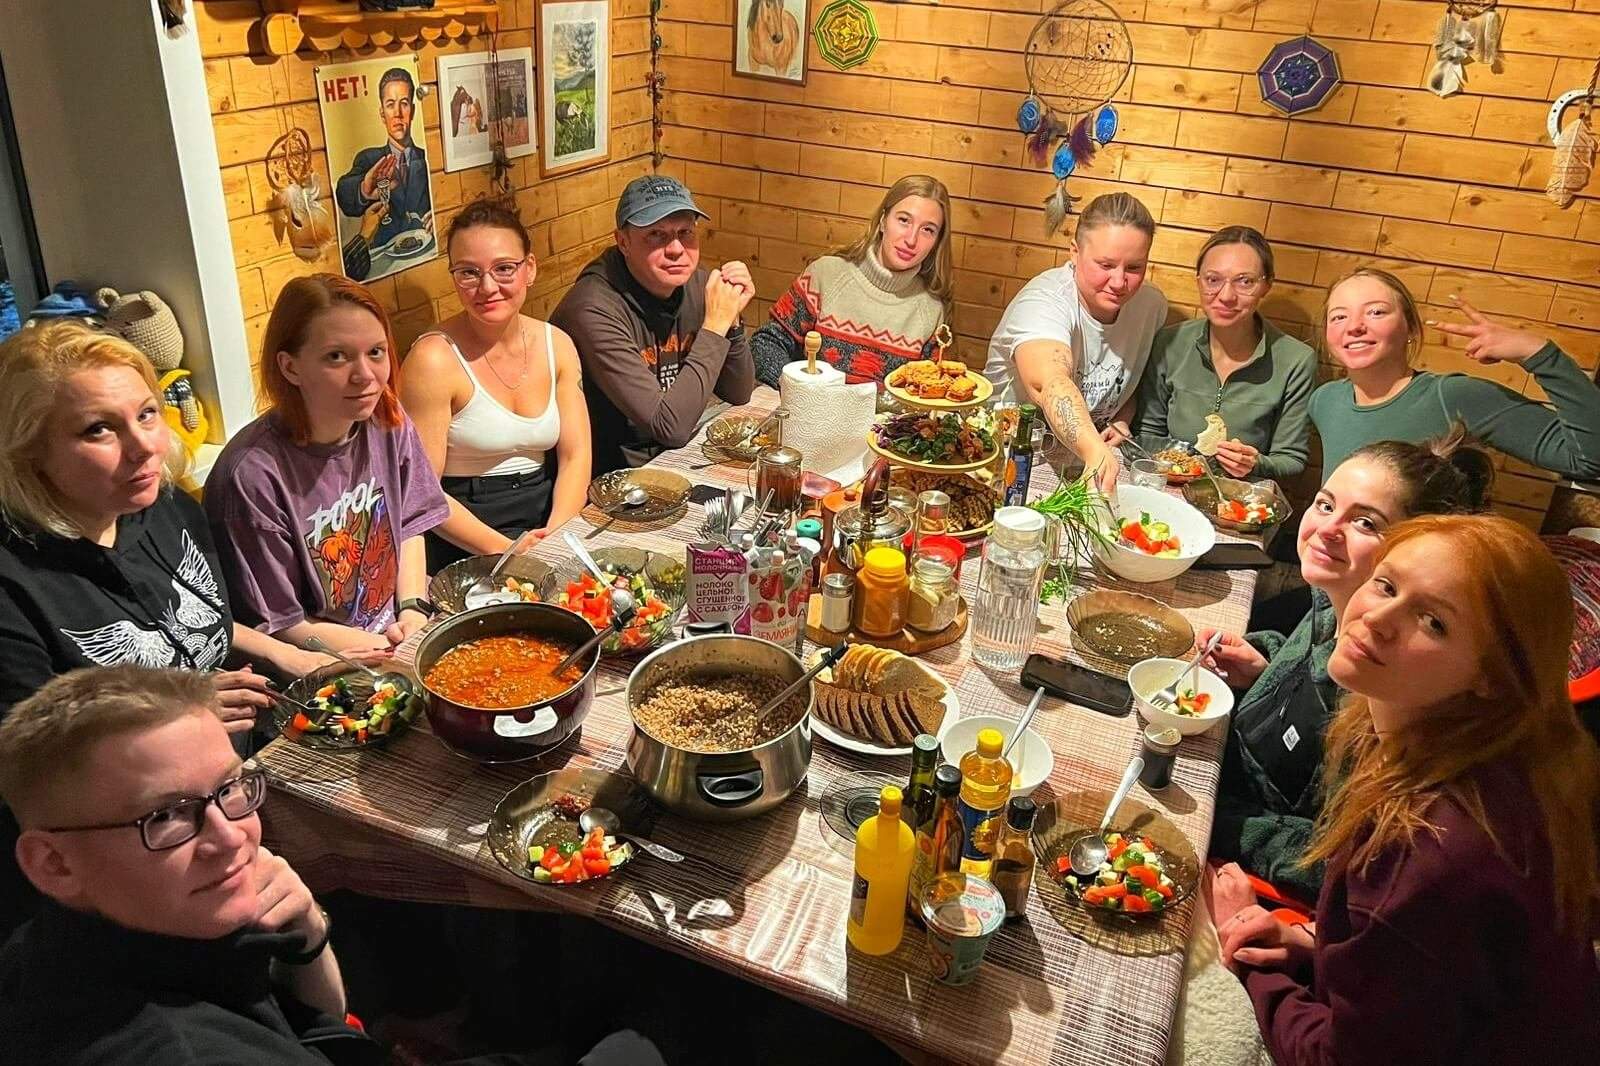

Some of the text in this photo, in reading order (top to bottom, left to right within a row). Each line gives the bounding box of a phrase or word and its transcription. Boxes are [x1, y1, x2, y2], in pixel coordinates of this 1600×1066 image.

[323, 75, 368, 103] НЕТ!
[696, 581, 733, 589] МОЛОКО
[696, 588, 734, 597] ЦЕЛЬНОЕ
[696, 595, 745, 604] СГУЩЕННОЕ
[704, 604, 744, 613] САХАРОМ
